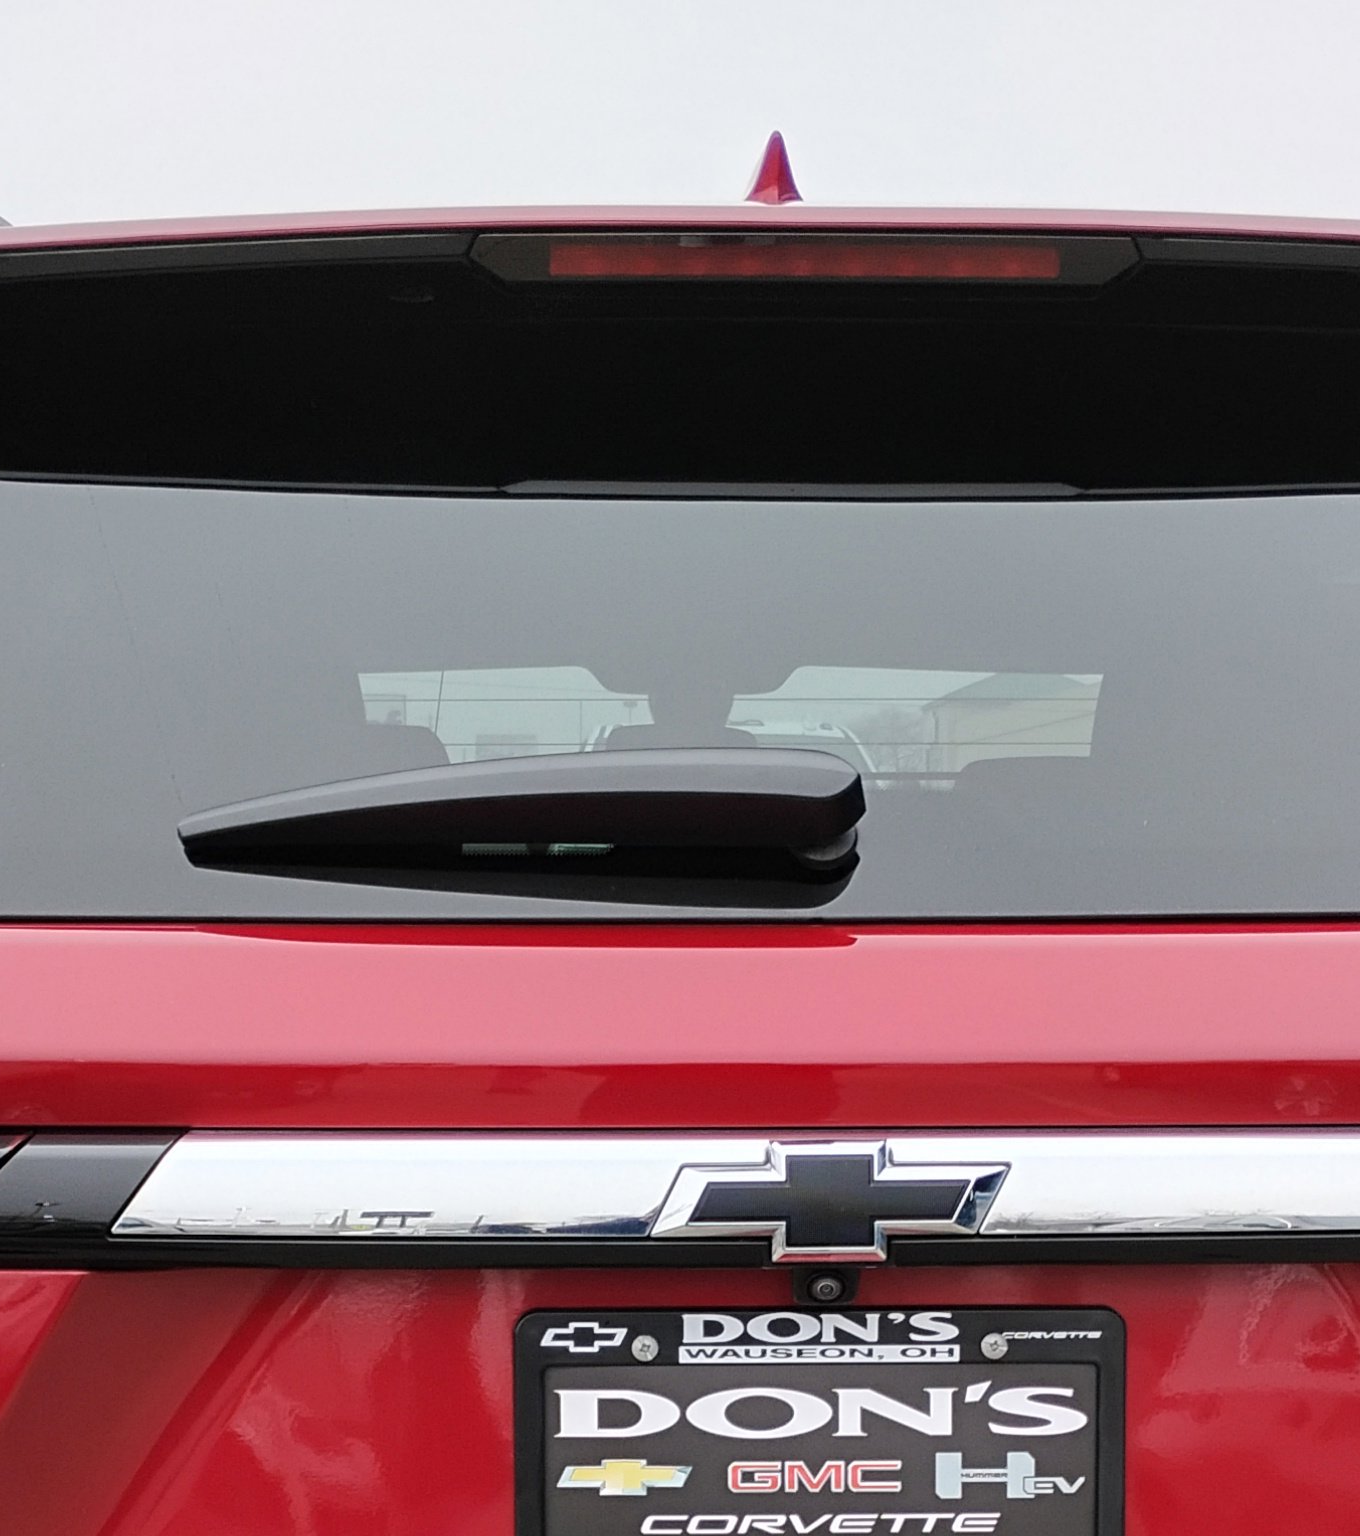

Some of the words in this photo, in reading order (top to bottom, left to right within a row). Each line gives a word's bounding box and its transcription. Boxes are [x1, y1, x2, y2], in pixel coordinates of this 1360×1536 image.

[681, 1312, 960, 1344] DON'S
[1002, 1330, 1103, 1340] CORVETTE
[685, 1346, 886, 1361] WAUSEON,
[900, 1347, 956, 1359] OH
[553, 1381, 1088, 1440] DON'S
[727, 1460, 903, 1494] GMC
[640, 1512, 1002, 1535] CORVETTE
